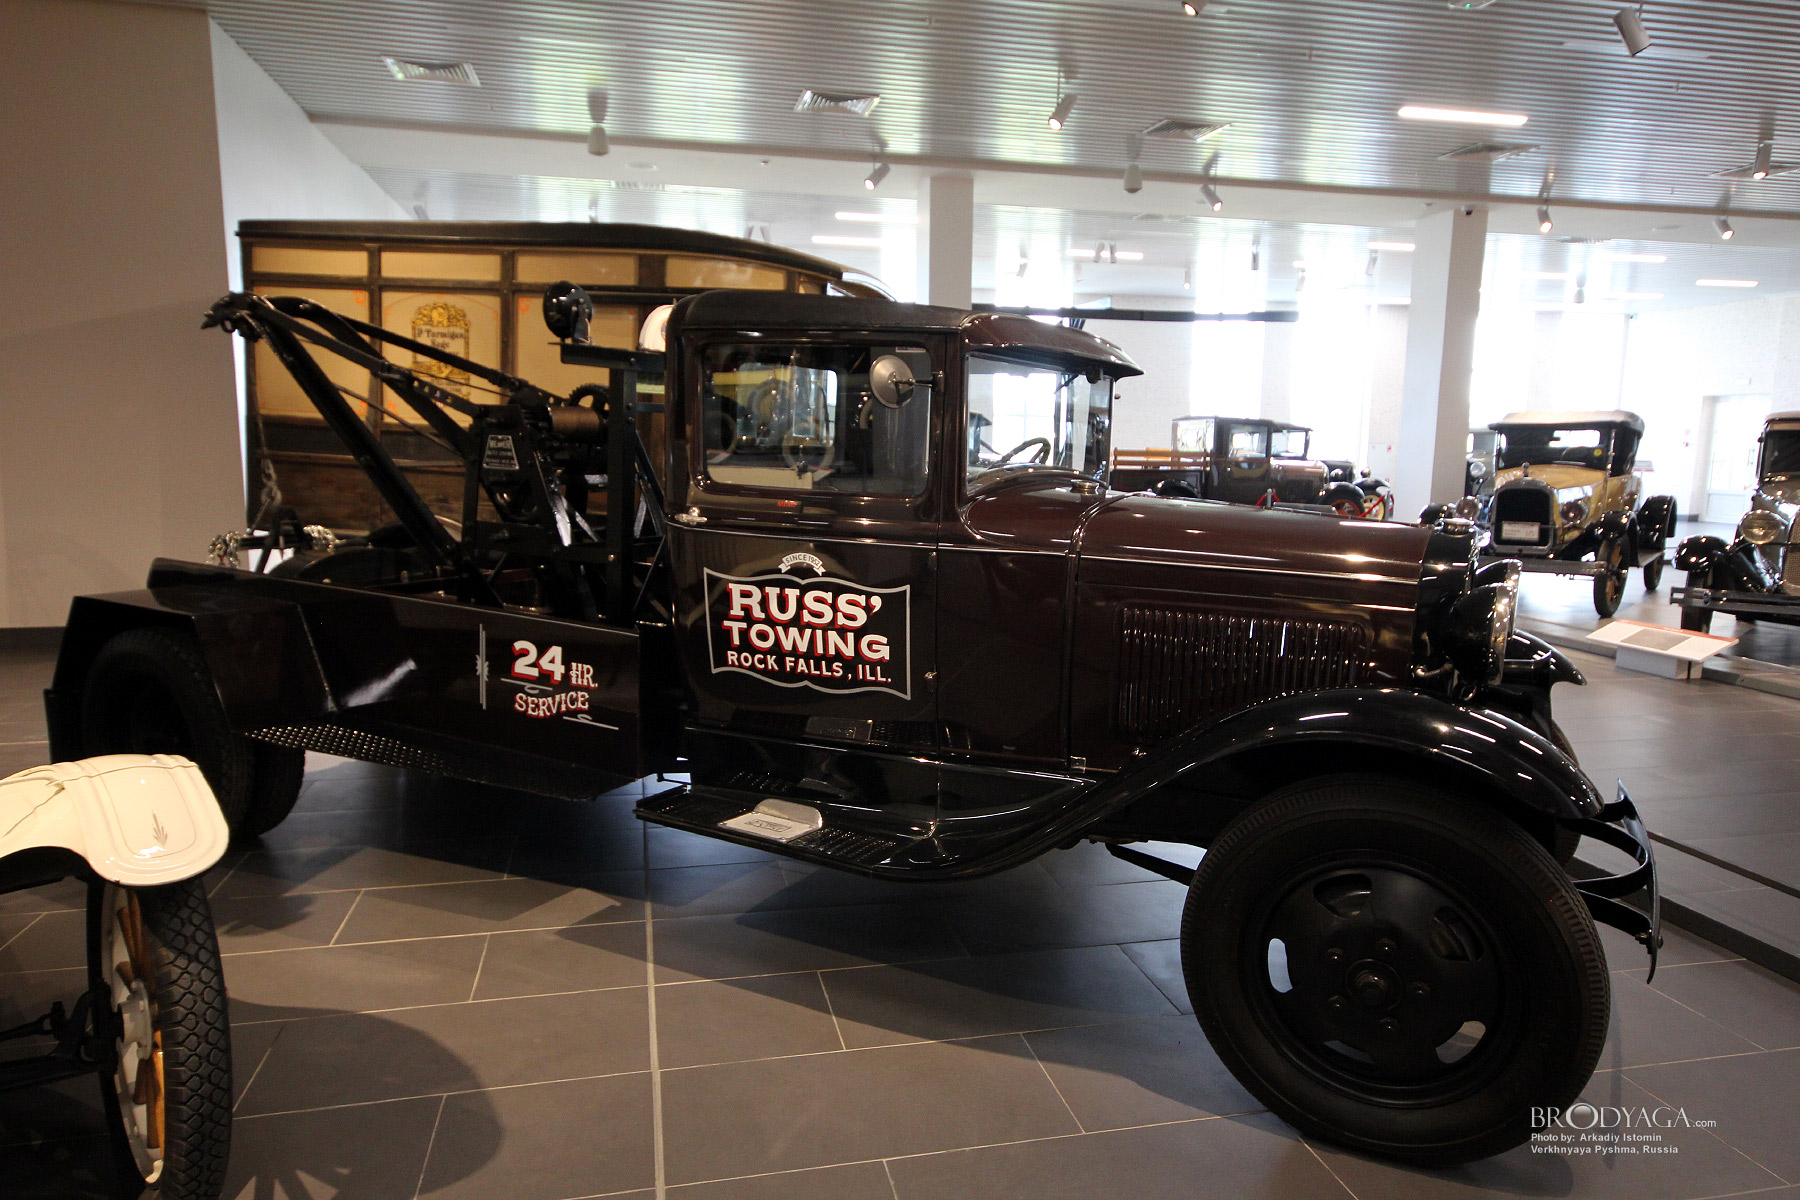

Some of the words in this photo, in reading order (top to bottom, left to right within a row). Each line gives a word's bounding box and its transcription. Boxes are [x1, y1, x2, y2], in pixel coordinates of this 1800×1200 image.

[784, 554, 807, 564] SINCE
[808, 556, 821, 567] 1952
[721, 620, 890, 662] TOWING
[511, 640, 565, 685] 24
[569, 662, 599, 690] HR.
[726, 650, 779, 672] ROCK
[784, 656, 852, 681] FALLS,
[857, 664, 892, 683] ILL.
[514, 690, 590, 718] SERVICE
